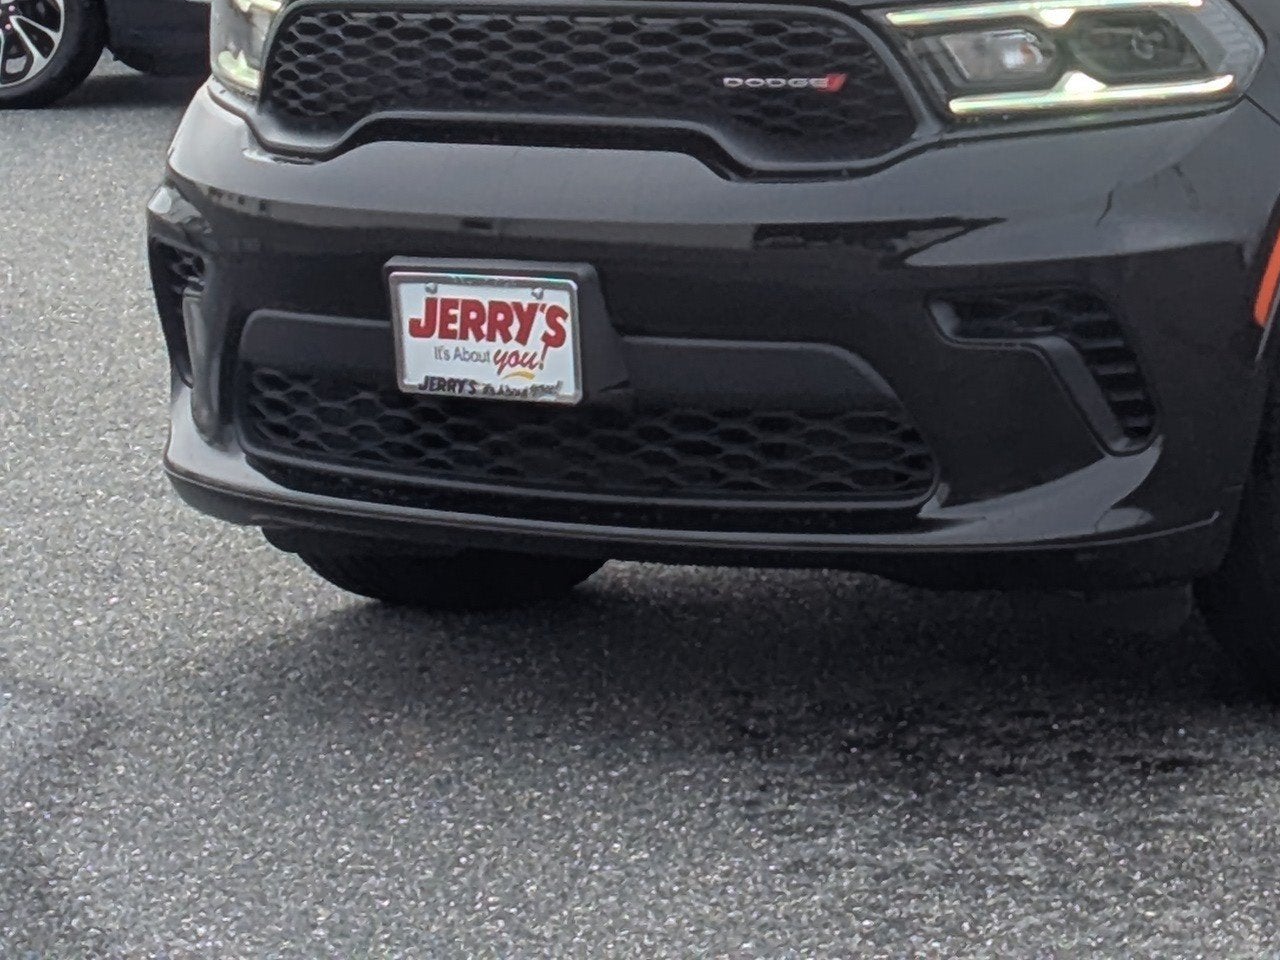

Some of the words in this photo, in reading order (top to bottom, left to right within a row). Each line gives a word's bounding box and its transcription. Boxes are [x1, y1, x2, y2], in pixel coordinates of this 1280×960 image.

[723, 77, 828, 88] DODGE
[408, 297, 569, 348] JERRY'S
[453, 346, 490, 363] About
[493, 343, 548, 376] you!
